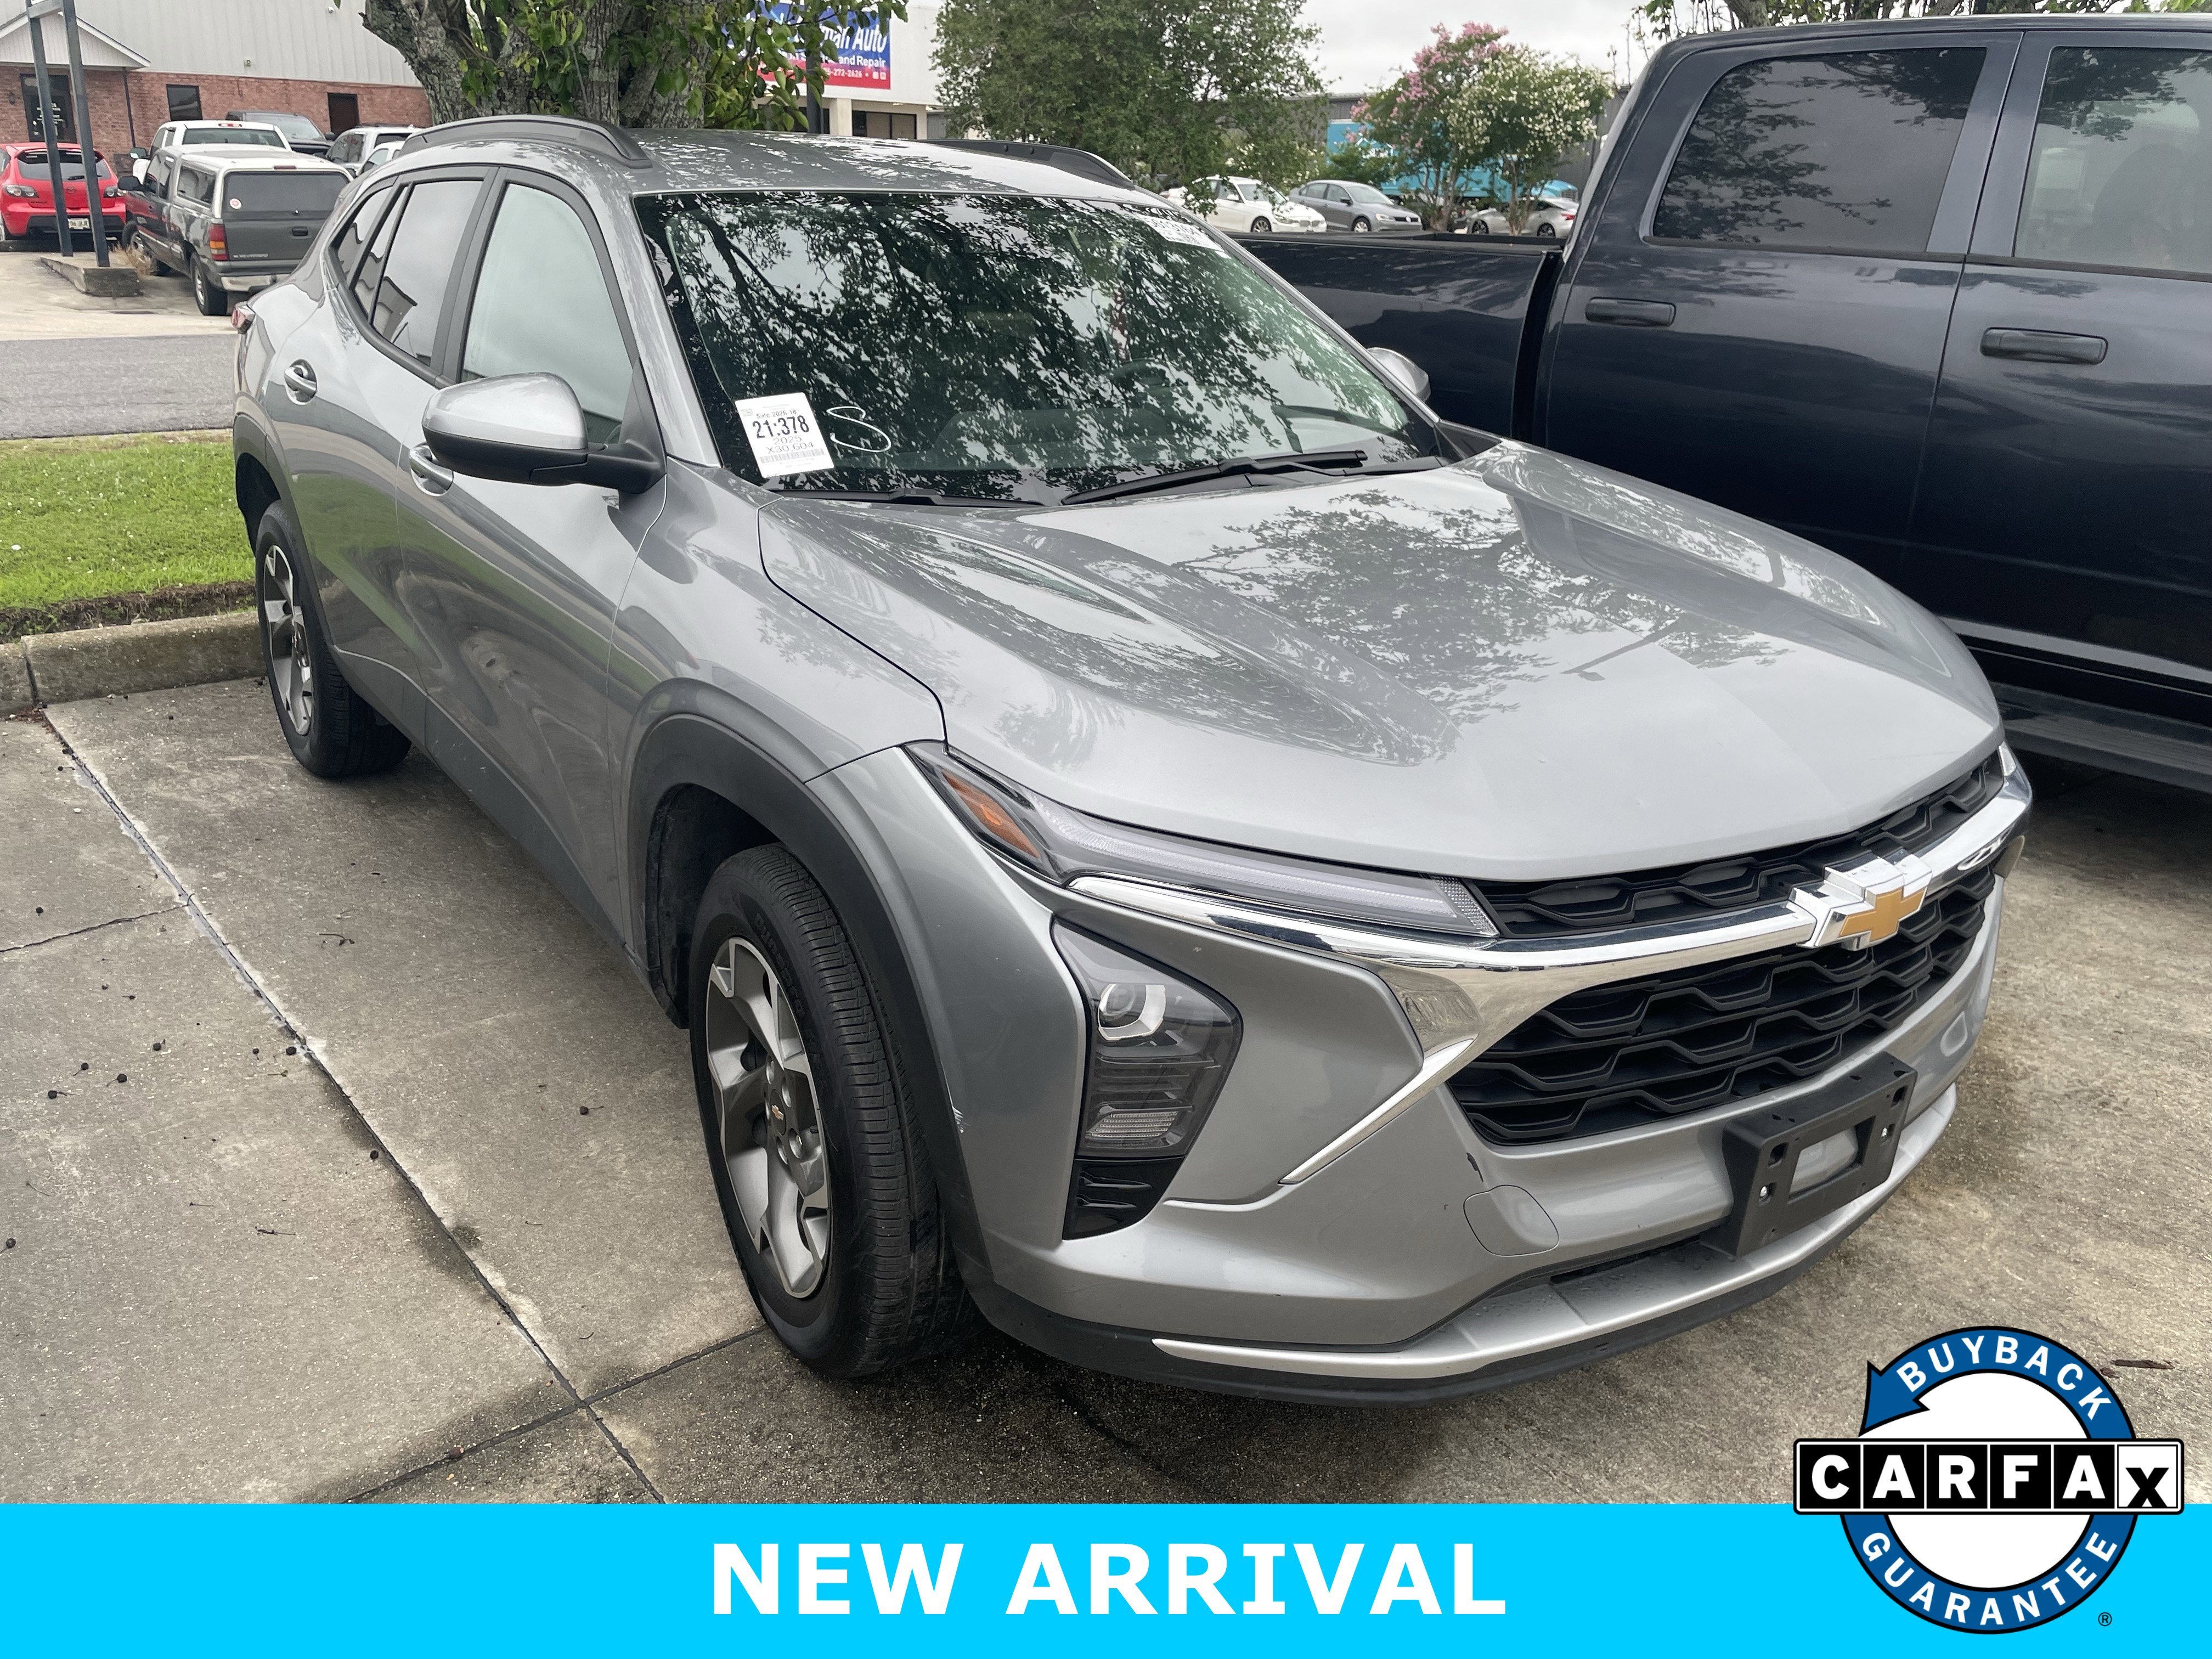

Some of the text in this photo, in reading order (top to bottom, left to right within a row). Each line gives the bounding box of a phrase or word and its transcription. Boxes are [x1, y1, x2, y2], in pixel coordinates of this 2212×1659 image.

[851, 24, 888, 53] Auto
[838, 55, 856, 65] and
[856, 55, 887, 69] Repair
[752, 415, 809, 439] 21:378
[773, 435, 802, 445] 2025
